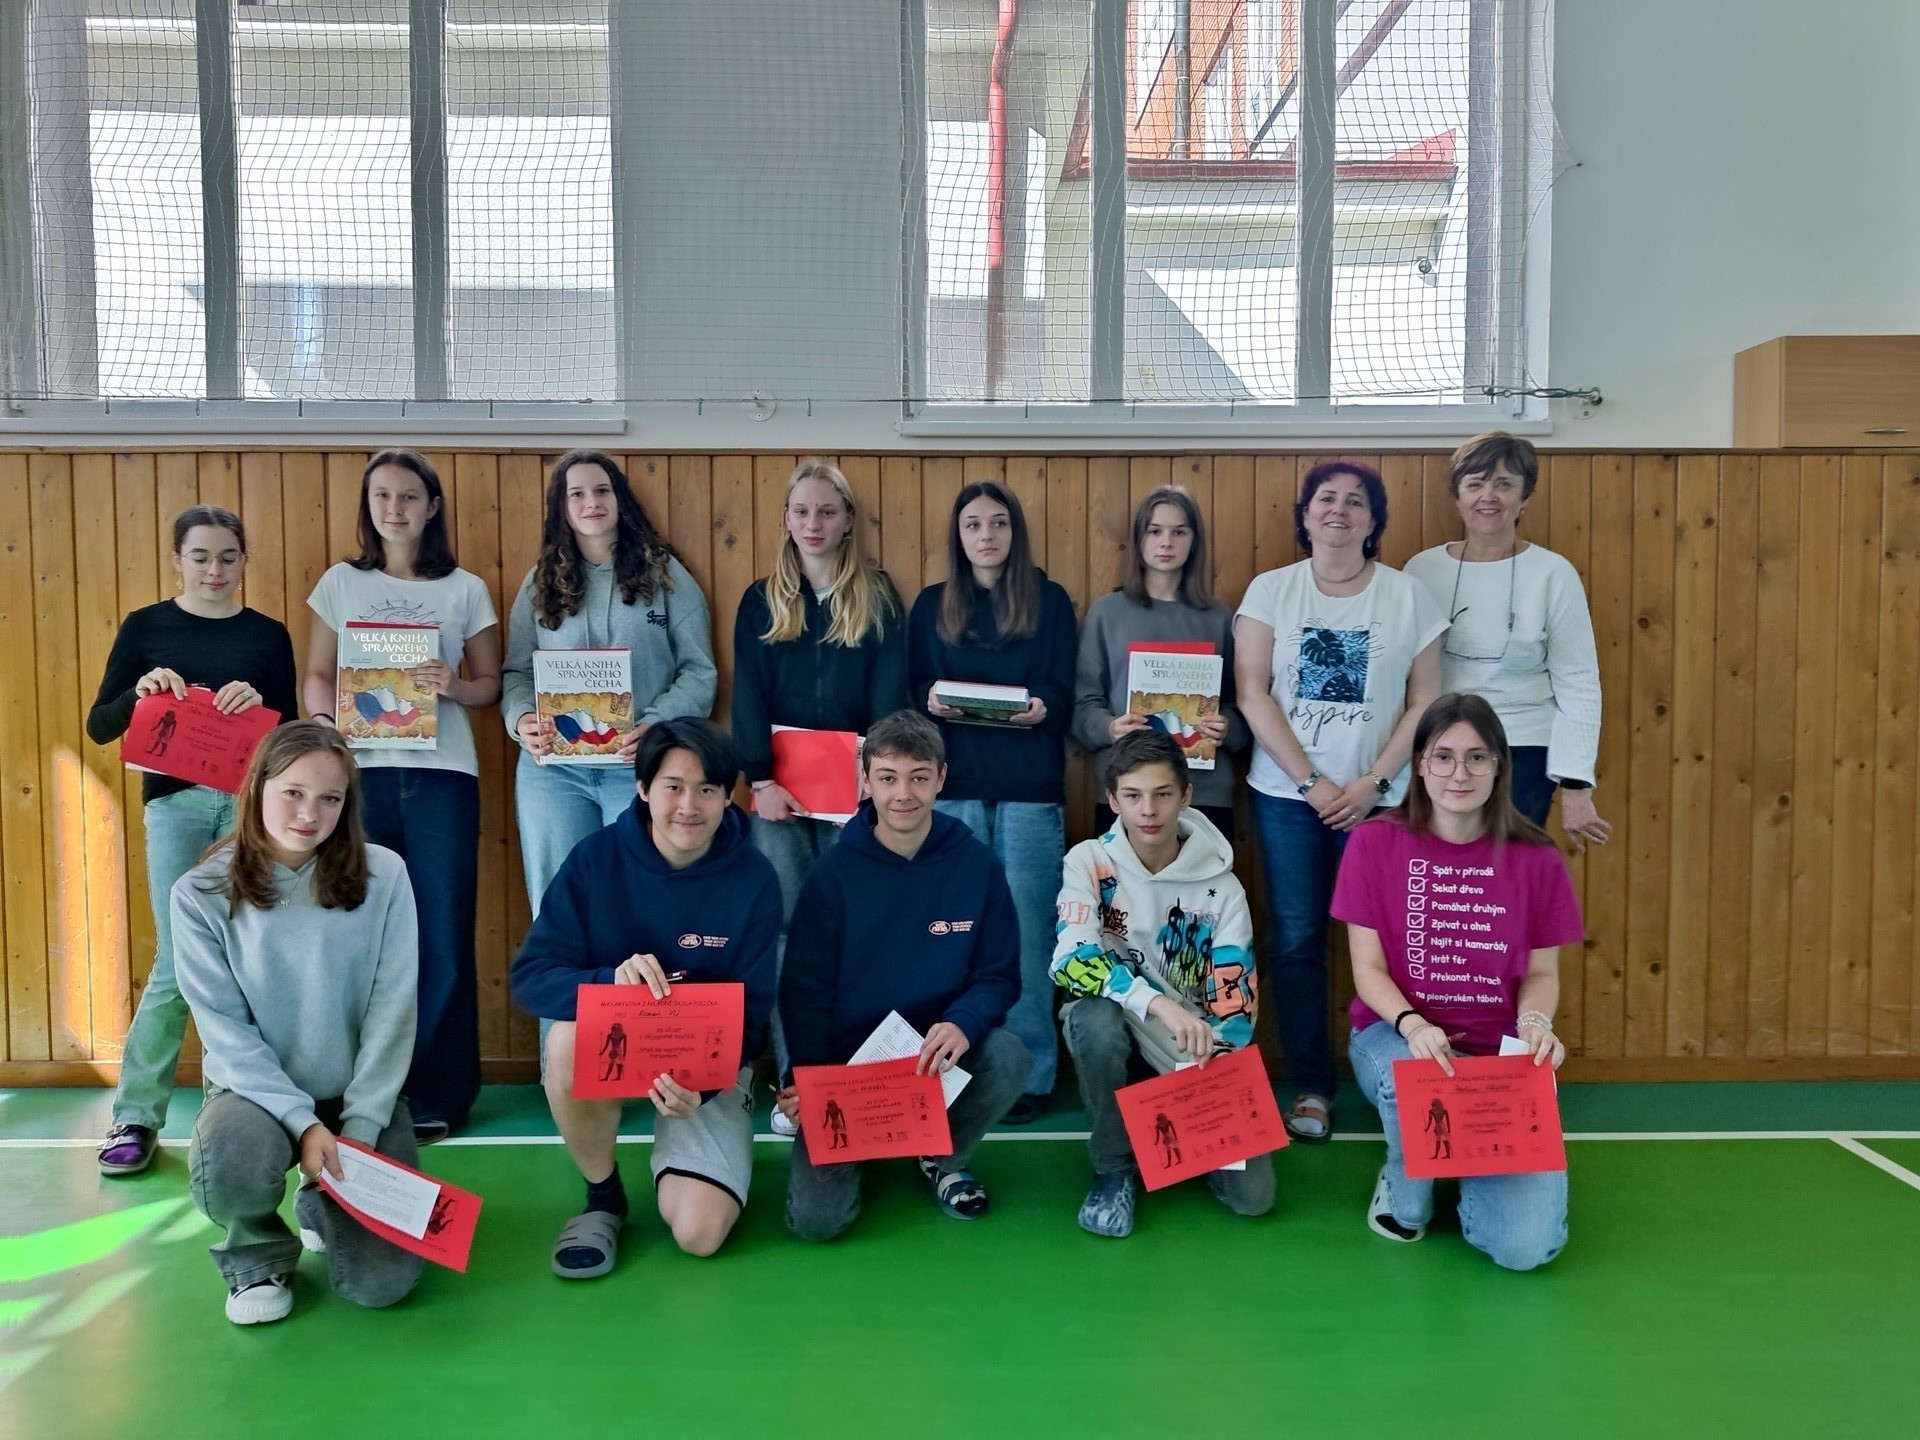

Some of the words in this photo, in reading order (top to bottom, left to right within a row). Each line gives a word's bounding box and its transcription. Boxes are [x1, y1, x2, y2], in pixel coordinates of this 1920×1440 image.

[352, 632, 387, 643] VELKÁ
[390, 633, 429, 643] KNIHA
[362, 641, 428, 653] SPRÁVNÉHO
[389, 652, 428, 663] ČECHA
[546, 659, 581, 669] VELKÁ
[584, 660, 621, 669] KNIHA
[1178, 661, 1213, 671] KNIHA
[558, 669, 622, 679] SPRÁVNÉHO
[584, 679, 622, 688] ČECHA
[1432, 865, 1453, 878] Spát
[1431, 883, 1457, 894] Sekat
[1459, 884, 1484, 895] dřevo
[1431, 901, 1471, 912] Pomáhat
[1472, 902, 1506, 917] druhým
[1431, 918, 1461, 931] Zpívat
[1462, 922, 1468, 931] u
[1470, 920, 1492, 932] ohně
[1430, 937, 1453, 949] Najít
[1454, 938, 1463, 947] si
[1465, 938, 1508, 954] kamarády
[1430, 954, 1450, 964] Hrát
[1452, 955, 1467, 965] fér
[1430, 971, 1471, 982] Překonat
[1473, 973, 1502, 986] strach
[1426, 992, 1475, 1003] pionýrském
